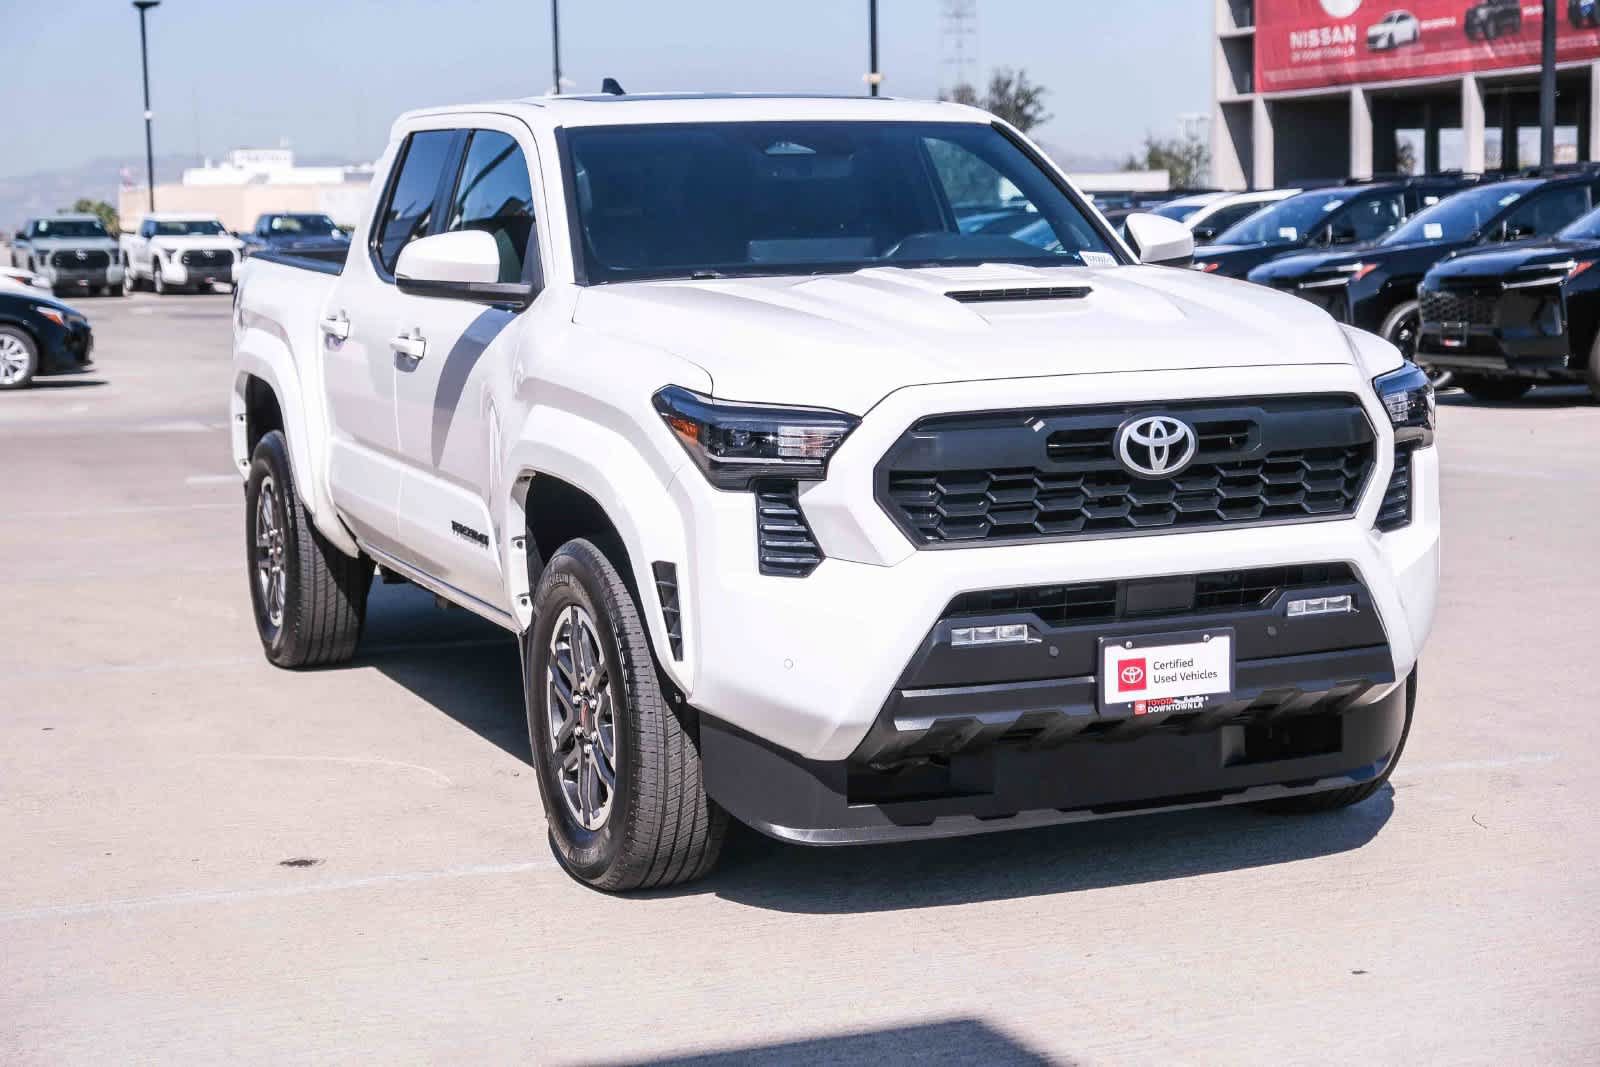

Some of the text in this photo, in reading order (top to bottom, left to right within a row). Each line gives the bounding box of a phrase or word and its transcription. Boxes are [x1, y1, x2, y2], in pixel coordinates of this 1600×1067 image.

[1290, 24, 1356, 48] NISSAN
[1153, 658, 1194, 671] Certified
[1153, 669, 1218, 684] Used Vehicles
[1147, 698, 1173, 706] TOYOTA
